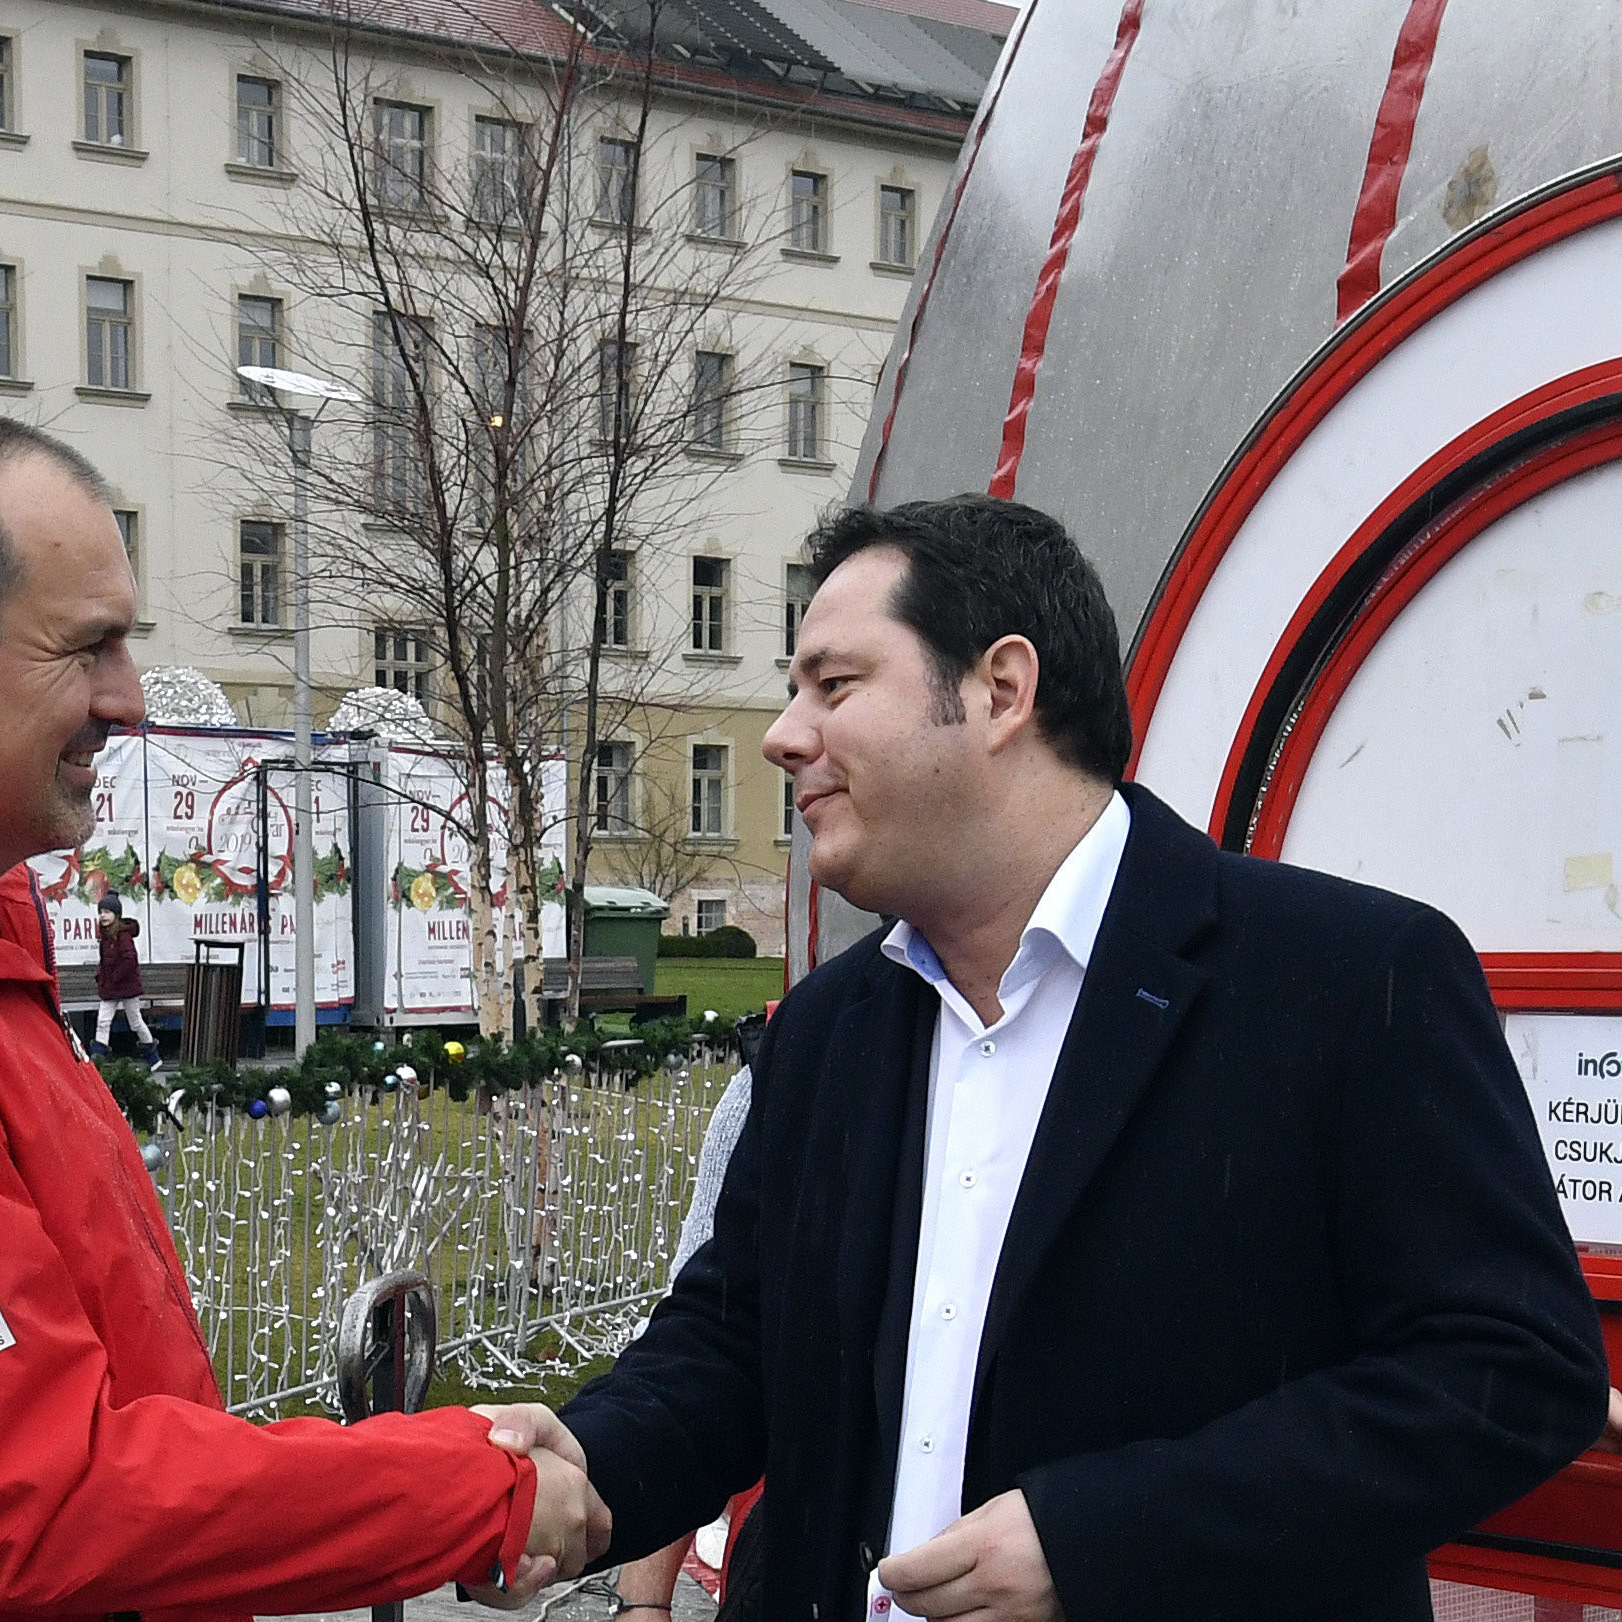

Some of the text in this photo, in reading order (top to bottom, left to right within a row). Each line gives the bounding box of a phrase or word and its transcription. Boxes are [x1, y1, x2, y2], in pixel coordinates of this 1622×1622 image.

[95, 793, 115, 823] 21
[173, 791, 195, 820] 29
[411, 805, 430, 833] 29
[427, 919, 469, 941] MILLEN
[1556, 1173, 1613, 1203] ÁTOR
